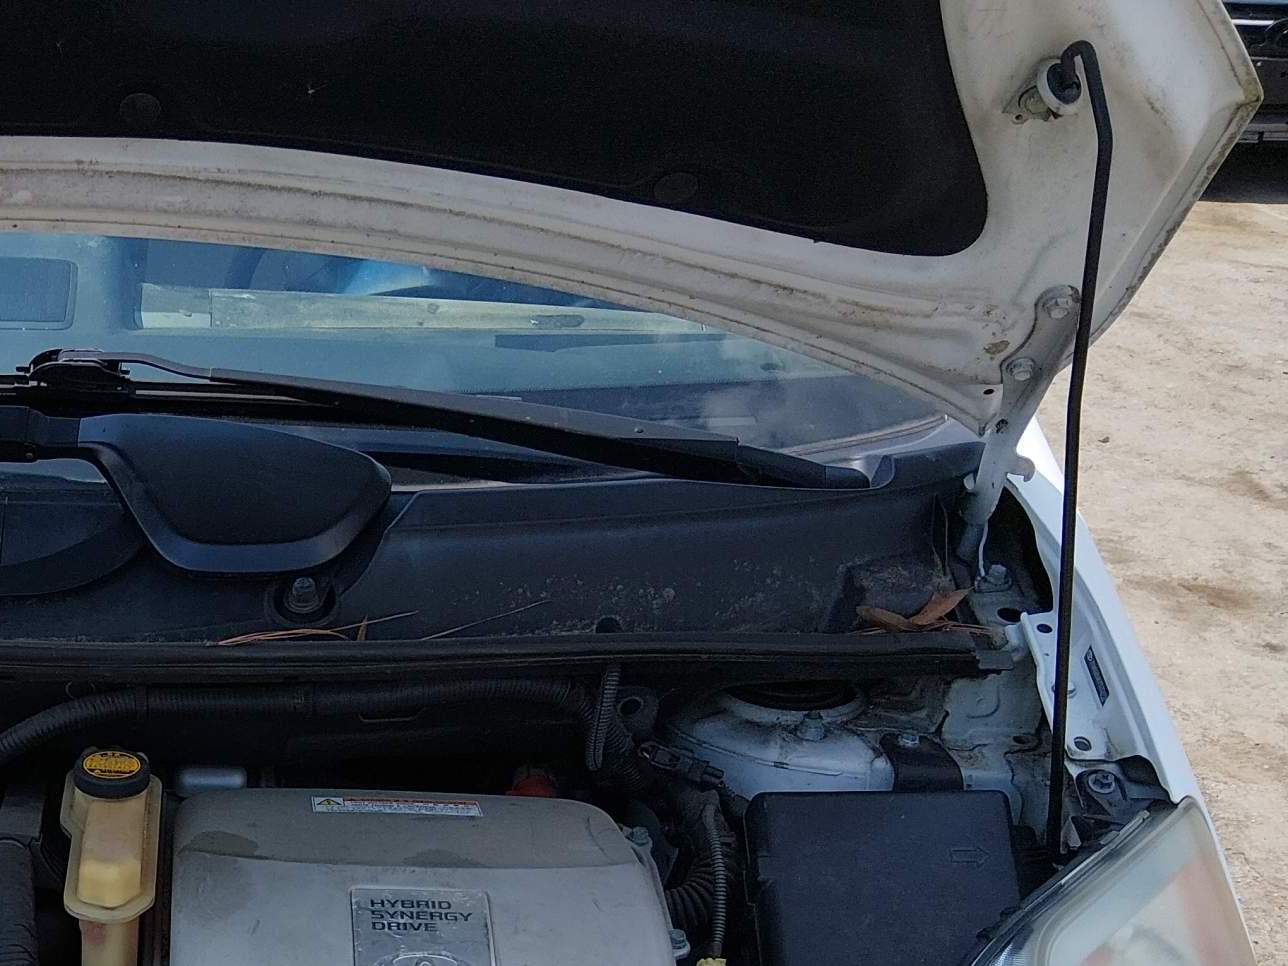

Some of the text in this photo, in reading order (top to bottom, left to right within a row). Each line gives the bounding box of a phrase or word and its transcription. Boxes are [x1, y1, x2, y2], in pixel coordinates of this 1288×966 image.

[370, 899, 452, 910] HYBRID
[370, 910, 473, 922] SYNERGY
[371, 921, 439, 932] DRIVE
